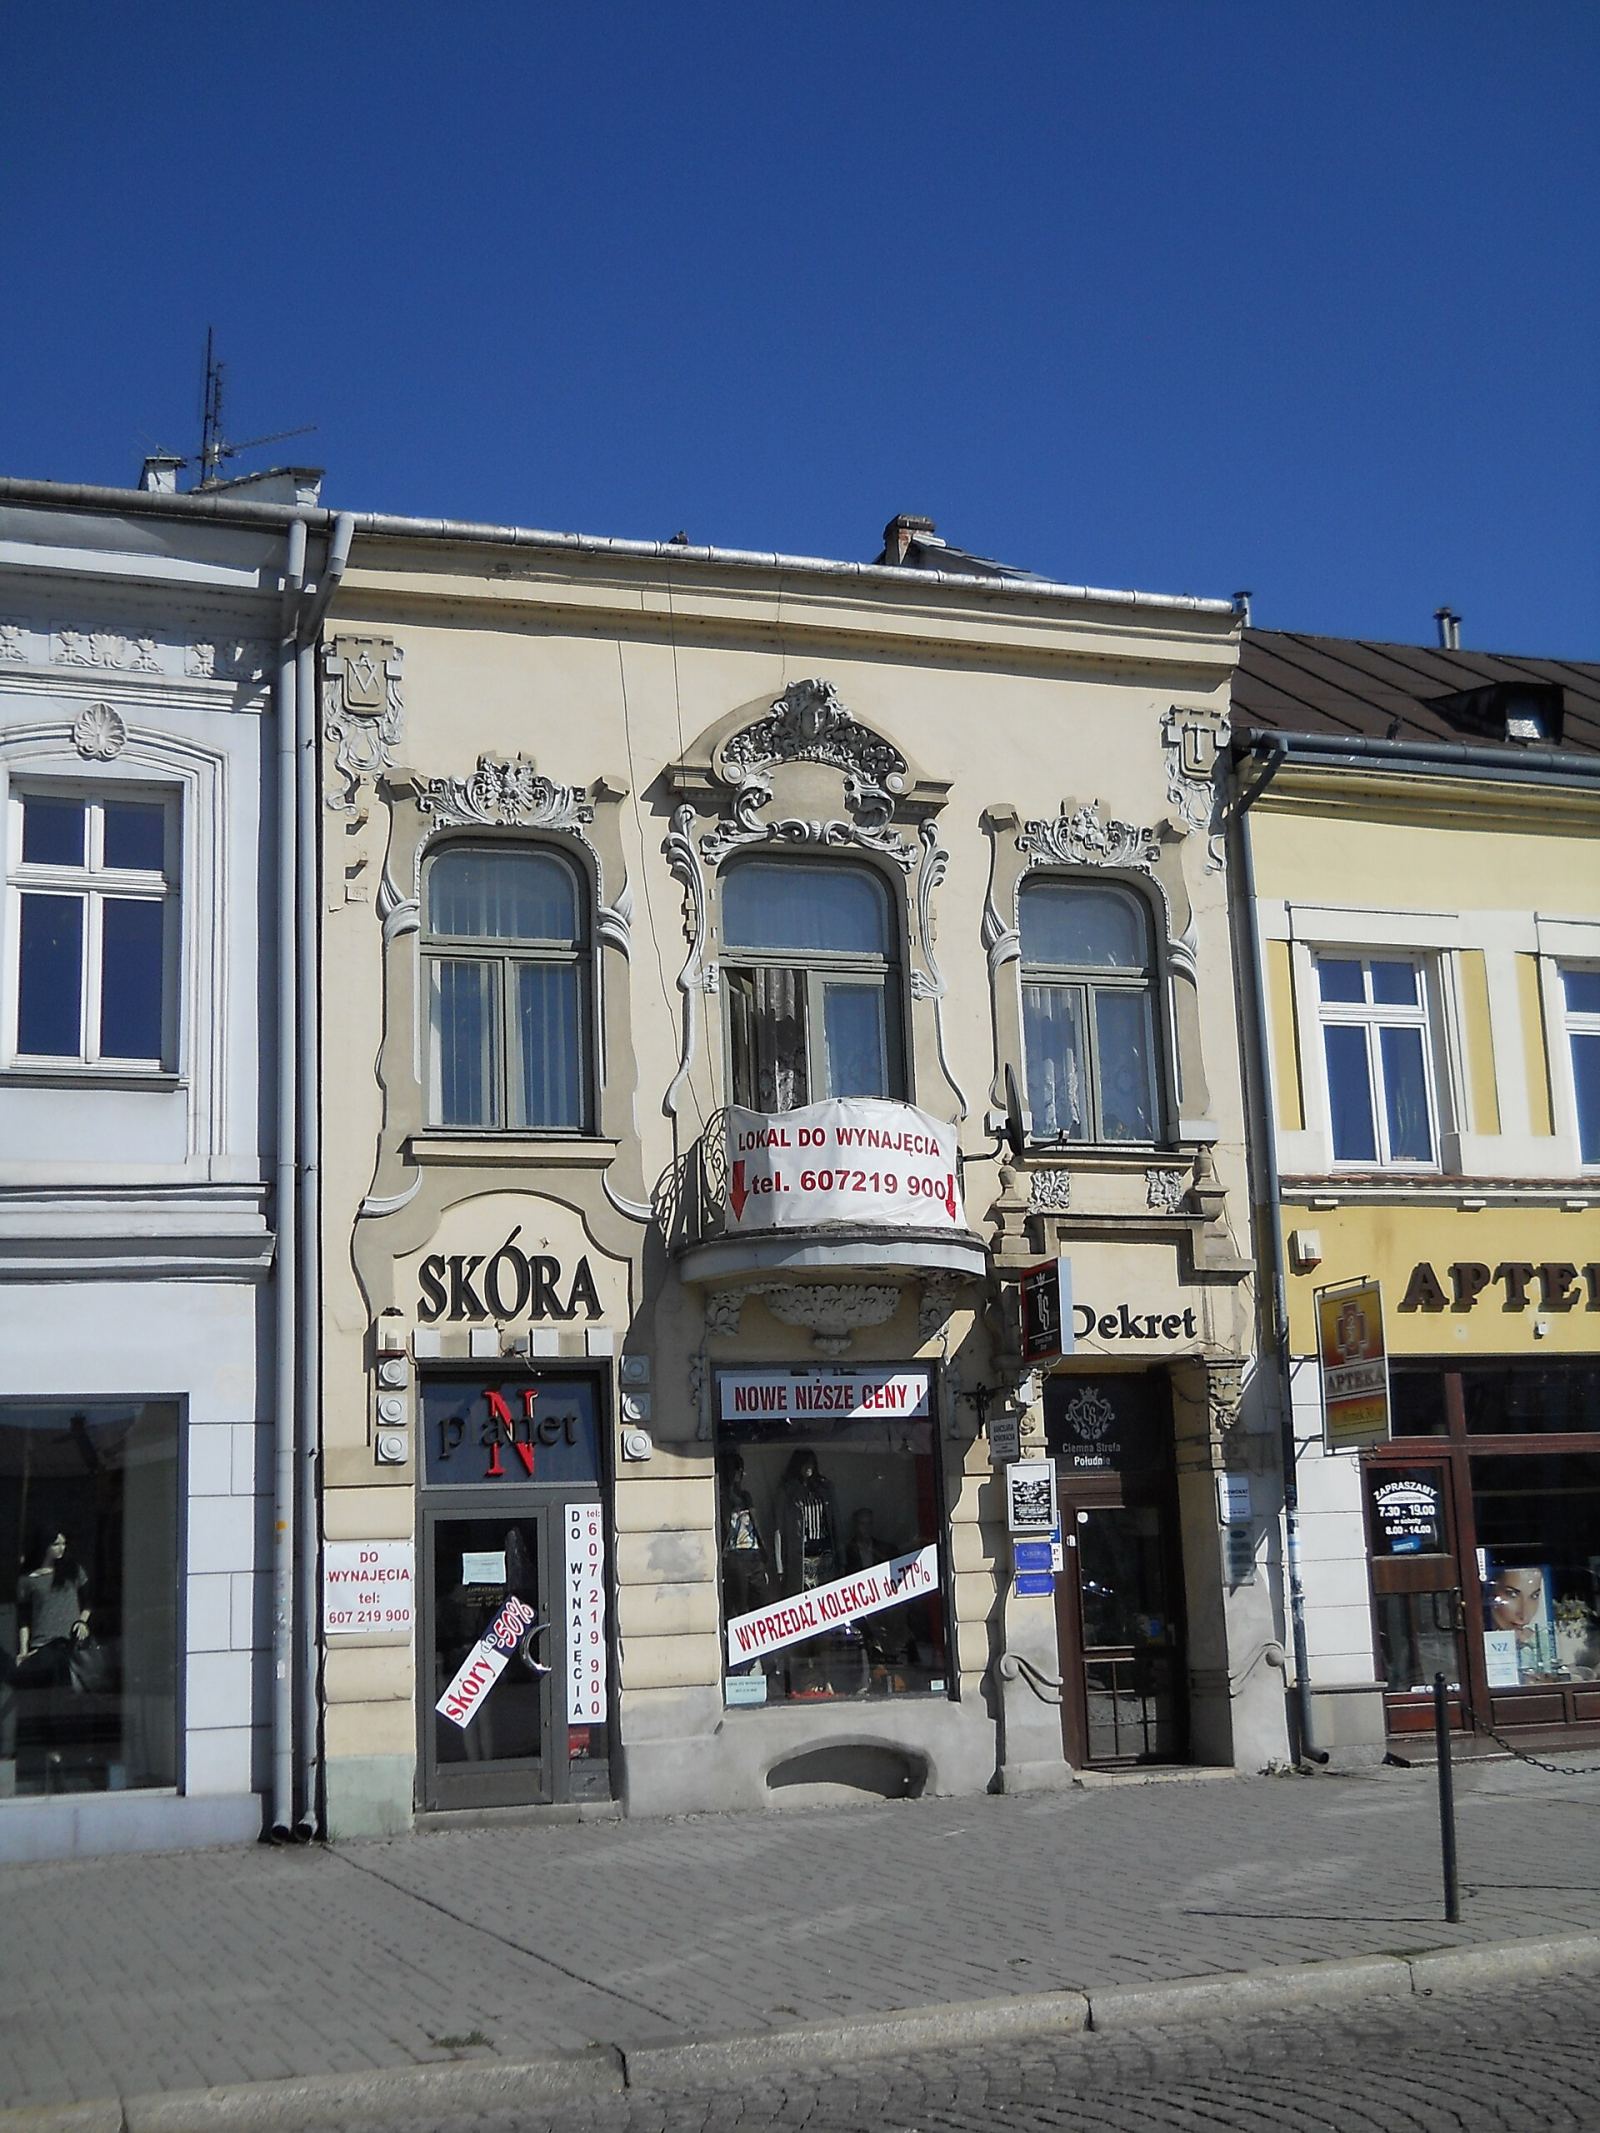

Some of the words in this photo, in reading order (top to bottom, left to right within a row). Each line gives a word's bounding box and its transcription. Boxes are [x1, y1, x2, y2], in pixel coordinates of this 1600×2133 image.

[738, 1128, 791, 1151] LOKAL
[799, 1127, 825, 1147] DO
[836, 1127, 940, 1157] WYNAJĘCIA
[752, 1171, 790, 1194] tel.
[800, 1170, 898, 1194] 607219
[907, 1175, 946, 1200] 900
[417, 1225, 604, 1322] SKÓRA
[1072, 1303, 1198, 1340] Dekret
[1327, 1368, 1386, 1392] APTEKA
[735, 1386, 787, 1411] NOWE
[795, 1378, 854, 1411] NIŻSZE
[861, 1384, 907, 1409] CENY
[438, 1407, 578, 1460] planet
[1062, 1443, 1094, 1453] Ciemna
[1096, 1442, 1120, 1452] Strefa
[1074, 1454, 1111, 1467] Południe
[1373, 1481, 1438, 1500] ZAPRASZAMY
[587, 1510, 600, 1518] tel:
[1378, 1505, 1400, 1517] 7.30
[1409, 1504, 1436, 1516] 19.00
[1385, 1525, 1403, 1535] 8.00
[1409, 1524, 1431, 1534] 14.00
[360, 1551, 379, 1563] DO
[328, 1568, 410, 1584] WYNAJĘCIA
[359, 1592, 380, 1604] tel:
[328, 1611, 353, 1624] 607
[357, 1610, 381, 1623] 219
[385, 1608, 410, 1621] 900
[735, 1595, 818, 1652] WYPRZEDAŻ
[817, 1577, 881, 1621] KOLEKCJI
[445, 1655, 497, 1721] skóry
